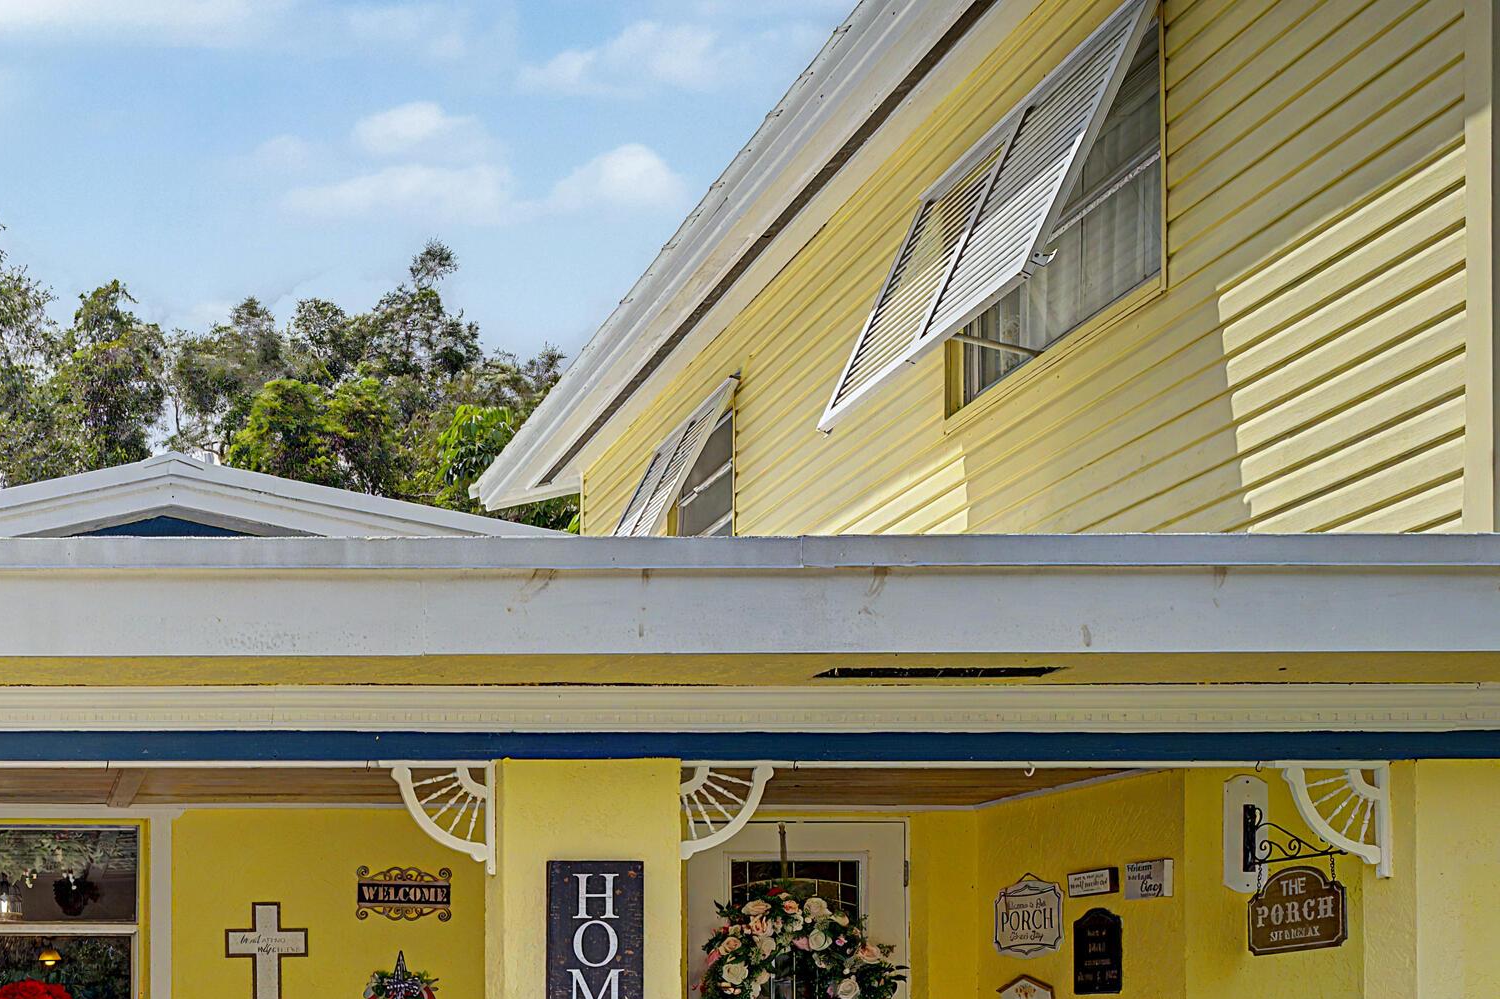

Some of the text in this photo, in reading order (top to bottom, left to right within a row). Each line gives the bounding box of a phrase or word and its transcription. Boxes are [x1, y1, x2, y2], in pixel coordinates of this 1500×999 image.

[362, 886, 447, 902] WELCOME
[1280, 877, 1307, 897] THE
[1001, 907, 1054, 932] PORCH
[1256, 895, 1335, 928] PORCH
